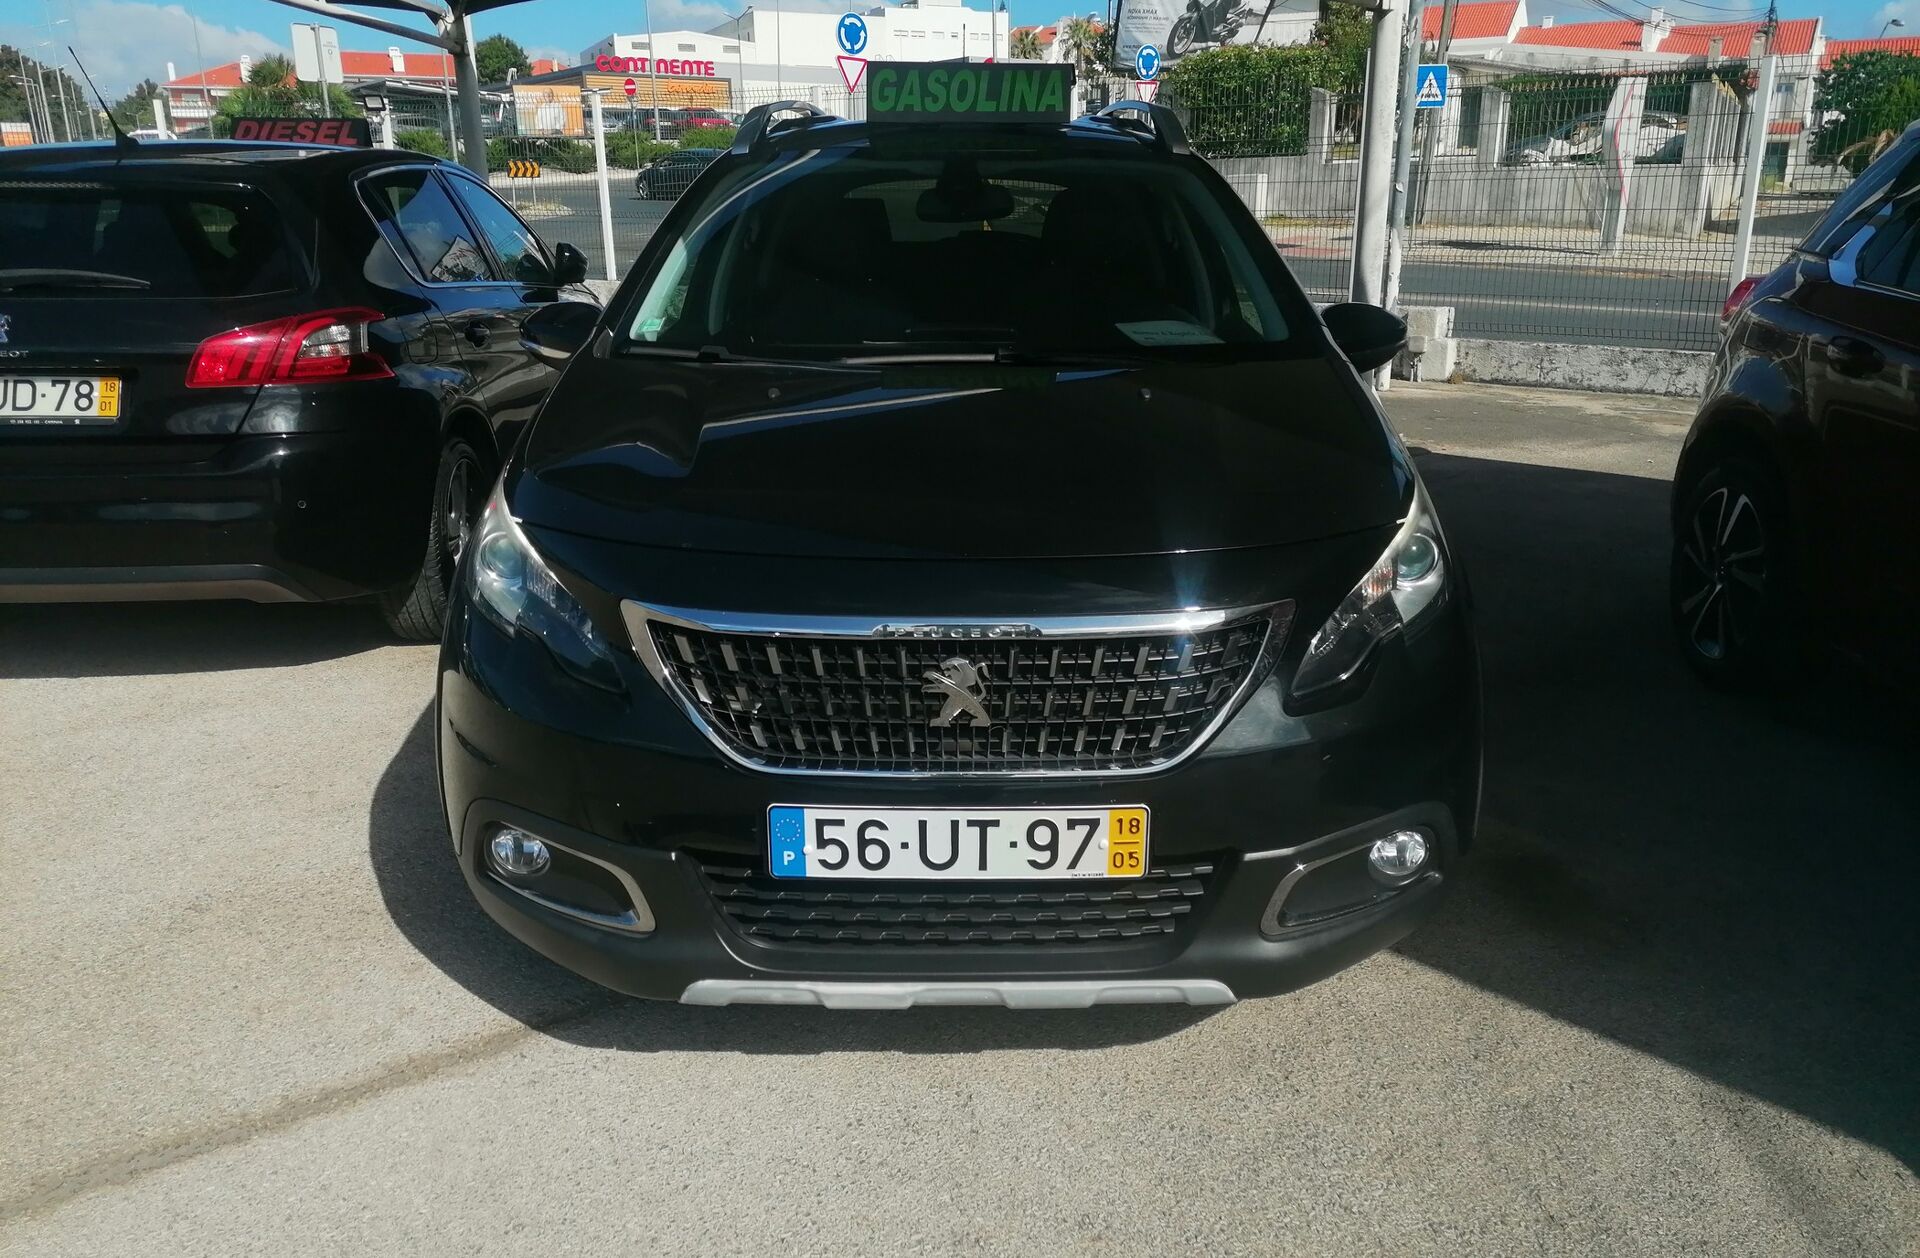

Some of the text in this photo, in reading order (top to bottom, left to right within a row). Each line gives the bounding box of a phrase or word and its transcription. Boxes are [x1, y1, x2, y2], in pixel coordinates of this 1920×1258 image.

[596, 54, 715, 77] CONTNENTE
[871, 68, 1064, 112] GASOLINA
[235, 120, 358, 145] DIESEL
[104, 382, 116, 392] 18
[100, 401, 112, 411] 01
[894, 627, 1020, 638] PEUGEOT
[1116, 817, 1140, 835] 18
[783, 851, 795, 865] P
[1112, 851, 1140, 869] 05
